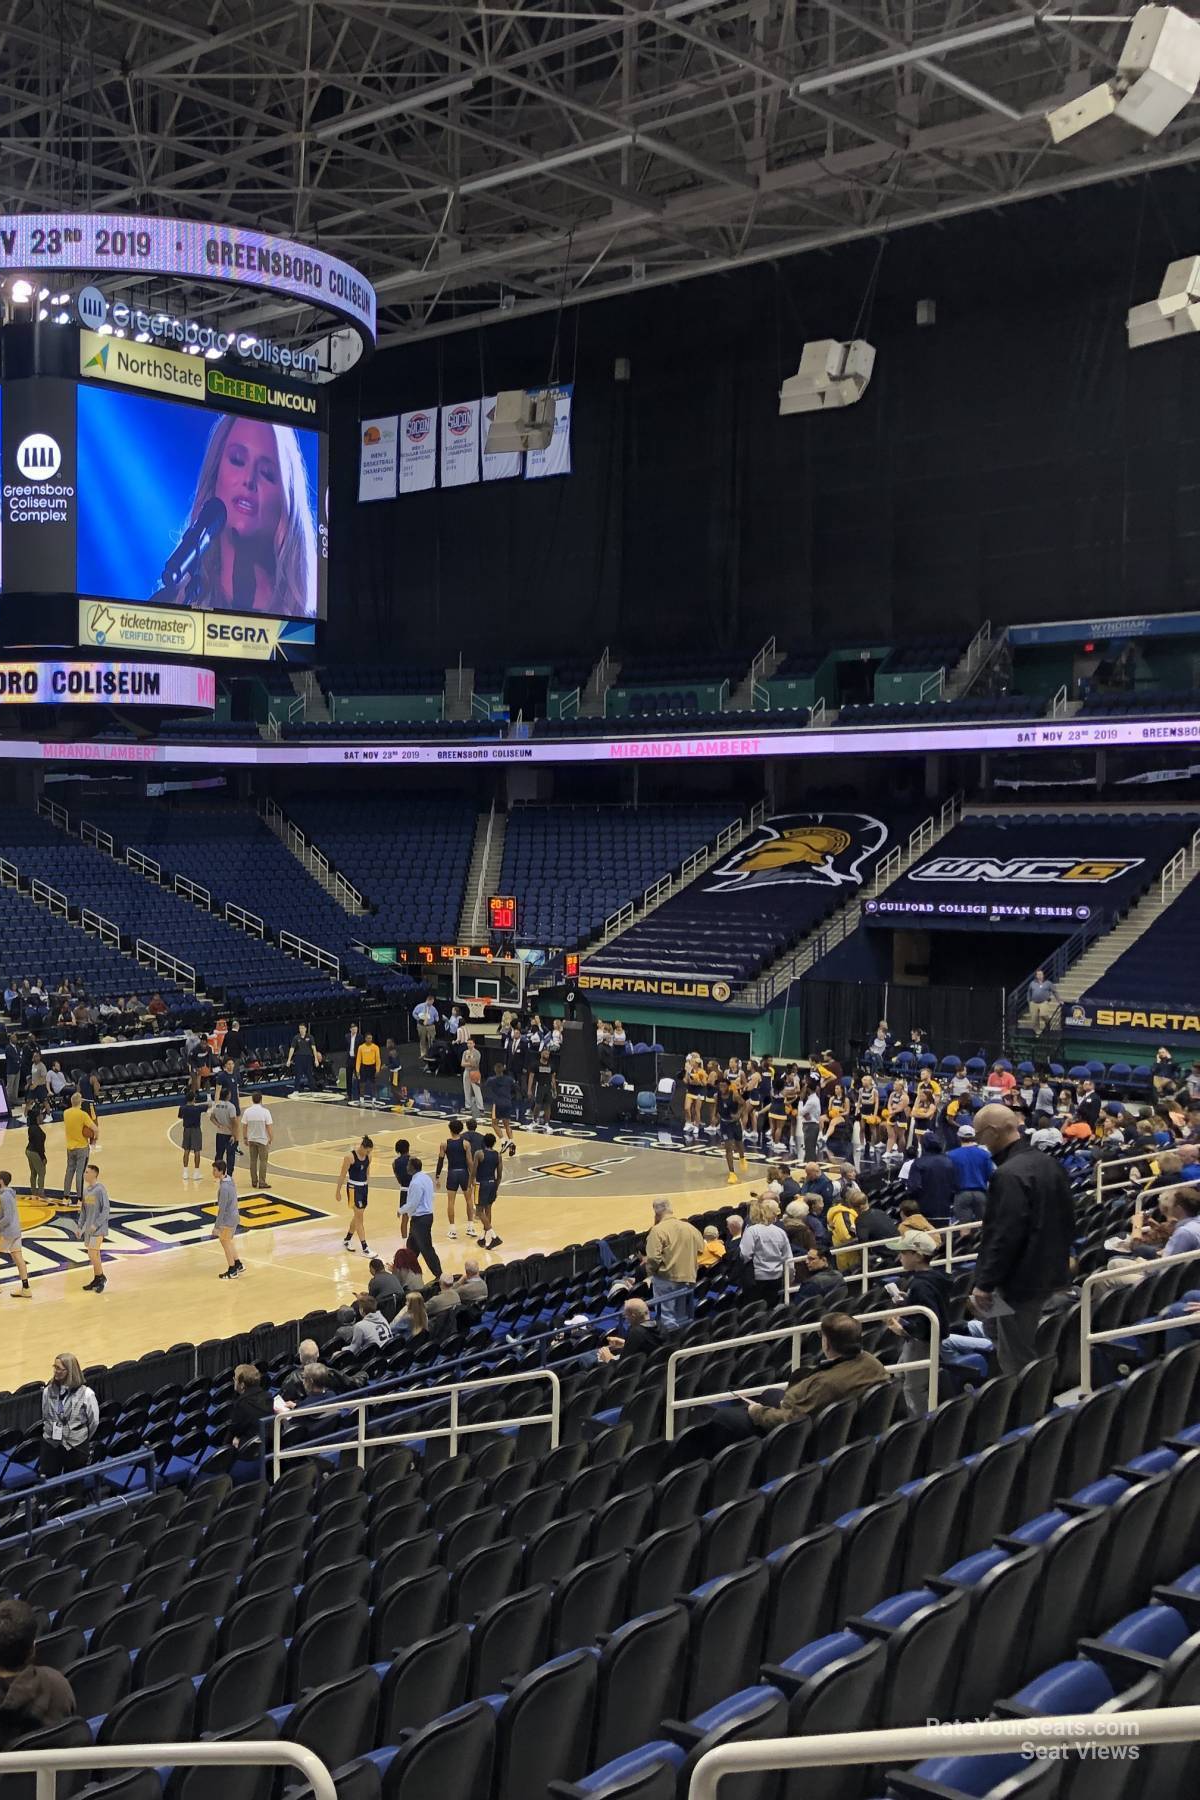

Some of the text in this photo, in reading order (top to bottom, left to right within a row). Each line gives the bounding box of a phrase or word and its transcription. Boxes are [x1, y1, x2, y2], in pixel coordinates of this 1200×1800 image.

[95, 230, 151, 256] 2019
[206, 239, 323, 288] GREENSBORO
[113, 302, 319, 373] Greensboro Coliseum
[118, 351, 202, 388] NorthState
[207, 370, 316, 414] GREEN LINCOLN
[3, 484, 74, 498] Greensboro
[9, 497, 67, 510] Coliseum
[9, 509, 67, 524] Complex
[120, 613, 189, 634] ticketmaster
[1091, 620, 1146, 632] WYNDHAM
[120, 629, 186, 645] VERIFIED TICKETS
[206, 623, 269, 643] SEGRA
[52, 670, 161, 696] COLISEUM
[1017, 732, 1037, 742] SAT
[1043, 731, 1063, 741] NOV
[1094, 729, 1118, 740] 2019
[1142, 726, 1200, 738] GREENSBO
[42, 743, 158, 761] MIRANDA LAMBERT
[344, 751, 359, 760] SAT
[363, 751, 378, 760] NOV
[401, 750, 420, 759] 2019
[437, 750, 488, 759] GREENSBORO
[492, 749, 532, 758] COLISEUM
[610, 739, 761, 758] MIRANDA LAMBERT
[912, 858, 1136, 882] UNCG
[491, 899, 514, 910] 20:13
[879, 902, 1073, 917] GUILFORD COLLEGE BRYAN SERIES
[492, 910, 511, 927] 30
[441, 947, 470, 957] 20:13
[578, 975, 710, 998] SPARTAN CLUB
[558, 1083, 584, 1096] TFA
